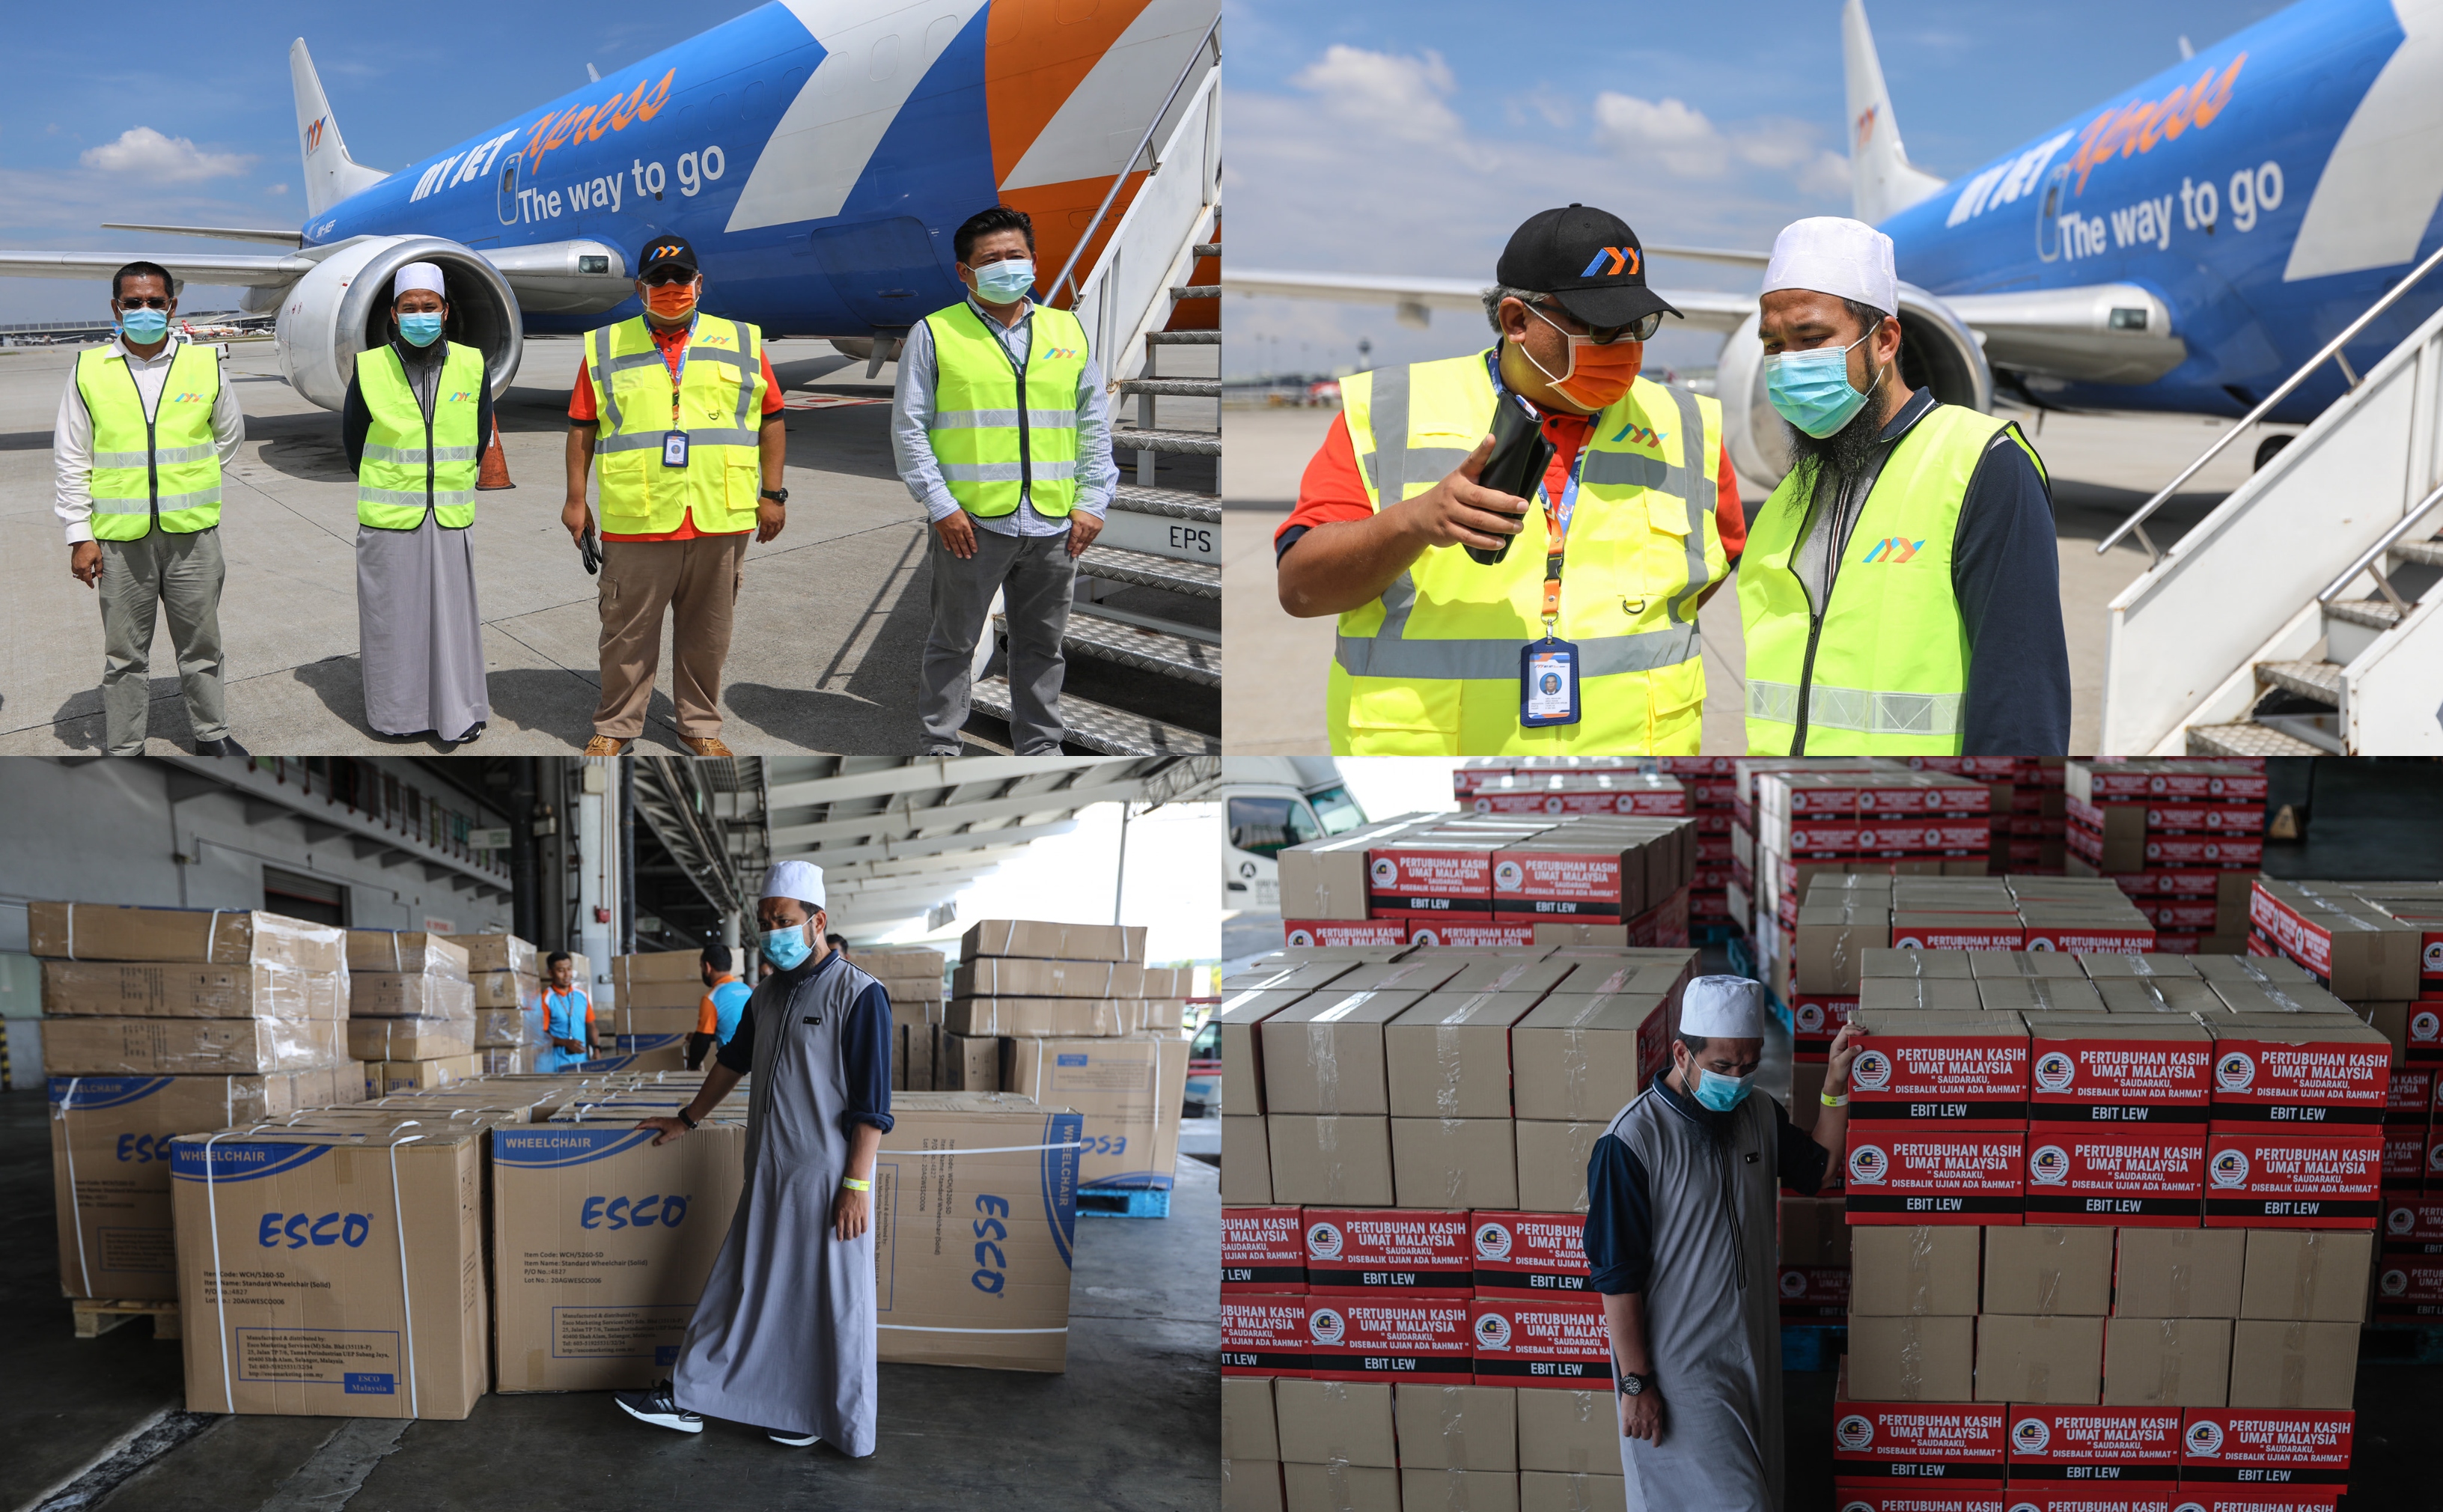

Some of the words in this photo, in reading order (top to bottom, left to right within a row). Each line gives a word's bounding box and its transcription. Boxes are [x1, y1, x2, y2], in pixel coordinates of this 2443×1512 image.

[409, 151, 455, 203] MY
[450, 127, 520, 188] JET
[518, 188, 561, 223] The
[570, 172, 623, 213] way
[632, 159, 665, 198] to
[677, 145, 725, 196] go
[2058, 211, 2107, 262] The
[2111, 194, 2174, 252] way
[2180, 176, 2219, 231] to
[2228, 160, 2285, 232] go
[1170, 525, 1211, 552] EPS
[1400, 857, 1458, 869] PERTUBUHAN
[1460, 859, 1488, 870] KASIH
[1409, 868, 1433, 878] UMAT
[1436, 868, 1480, 880] MALAYSIA
[1411, 898, 1430, 909] EBIT
[1431, 899, 1450, 909] LEW
[1897, 1049, 1982, 1061] PERTUBUHAN
[1988, 1049, 2025, 1061] KASIH
[2262, 1052, 2345, 1066] PERTUBUHAN
[2349, 1055, 2387, 1067] KASIH
[1909, 1062, 1945, 1073] UMAT
[1950, 1061, 2013, 1073] MALAYSIA
[2273, 1065, 2308, 1078] UMAT
[2312, 1067, 2373, 1079] MALAYSIA
[55, 1084, 122, 1093] WHELCHAIR
[2257, 1088, 2298, 1097] DISEBALIK
[2301, 1089, 2325, 1097] UJIAN
[2327, 1090, 2343, 1098] ADA
[2346, 1091, 2379, 1099] RAHMAT
[1912, 1105, 1937, 1116] EBIT
[1942, 1105, 1966, 1116] LEW
[2271, 1107, 2297, 1119] EBIT
[2300, 1108, 2325, 1120] LEW
[117, 1133, 176, 1163] ESC
[505, 1138, 591, 1148] WHEELCHAIR
[1079, 1135, 1127, 1156] ESC
[180, 1151, 266, 1162] WHEELCHAIR
[1346, 1222, 1425, 1234] PERTUBUHAN
[1430, 1223, 1466, 1234] KASIH
[1359, 1234, 1391, 1246] UMAT
[1396, 1234, 1454, 1246] MALAYSIA
[1364, 1273, 1388, 1284] EBIT
[1391, 1273, 1415, 1284] LEW
[352, 1384, 387, 1393] Malaysia
[2230, 1420, 2310, 1433] PERTUBUHAN
[2314, 1422, 2350, 1433] KASIH
[2240, 1433, 2274, 1443] UMAT
[2278, 1433, 2337, 1445] MALAYSIA
[2239, 1470, 2263, 1481] EBIT
[2266, 1470, 2291, 1481] LEW
